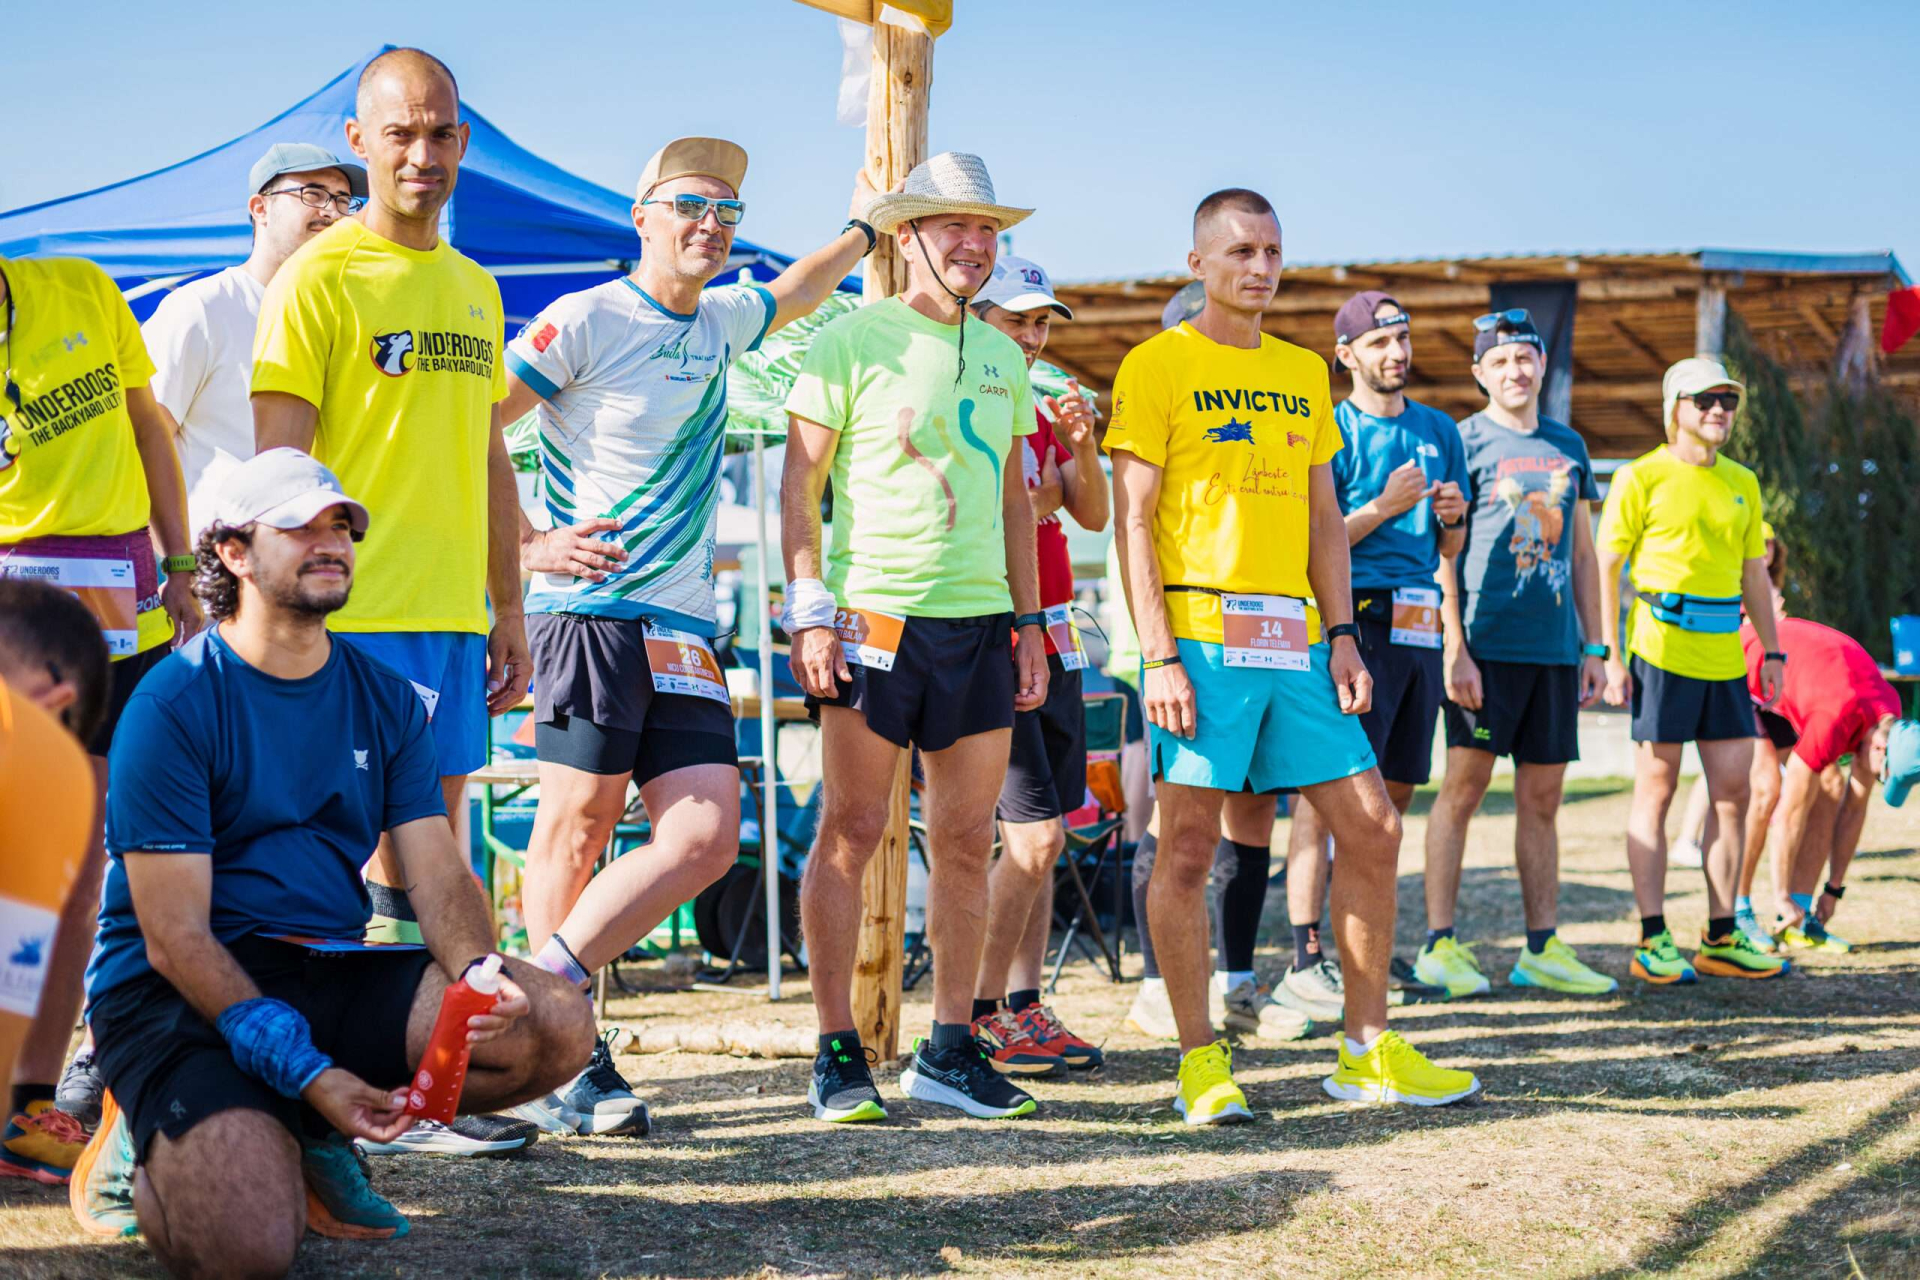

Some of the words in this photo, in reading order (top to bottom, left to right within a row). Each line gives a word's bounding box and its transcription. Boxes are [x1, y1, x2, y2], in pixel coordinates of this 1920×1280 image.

[417, 330, 494, 365] UNDERDOGS
[417, 357, 430, 372] THE
[15, 362, 120, 431] UNDERDOGS
[1193, 388, 1311, 418] INVICTUS
[28, 425, 53, 447] THE
[50, 400, 105, 437] BACKYARD
[19, 565, 60, 575] UNDERDOGS
[1237, 600, 1264, 608] UNDERDOGS
[834, 610, 859, 631] 21
[1260, 620, 1284, 638] 14
[1250, 638, 1269, 647] FLORIN
[680, 647, 702, 667] 26
